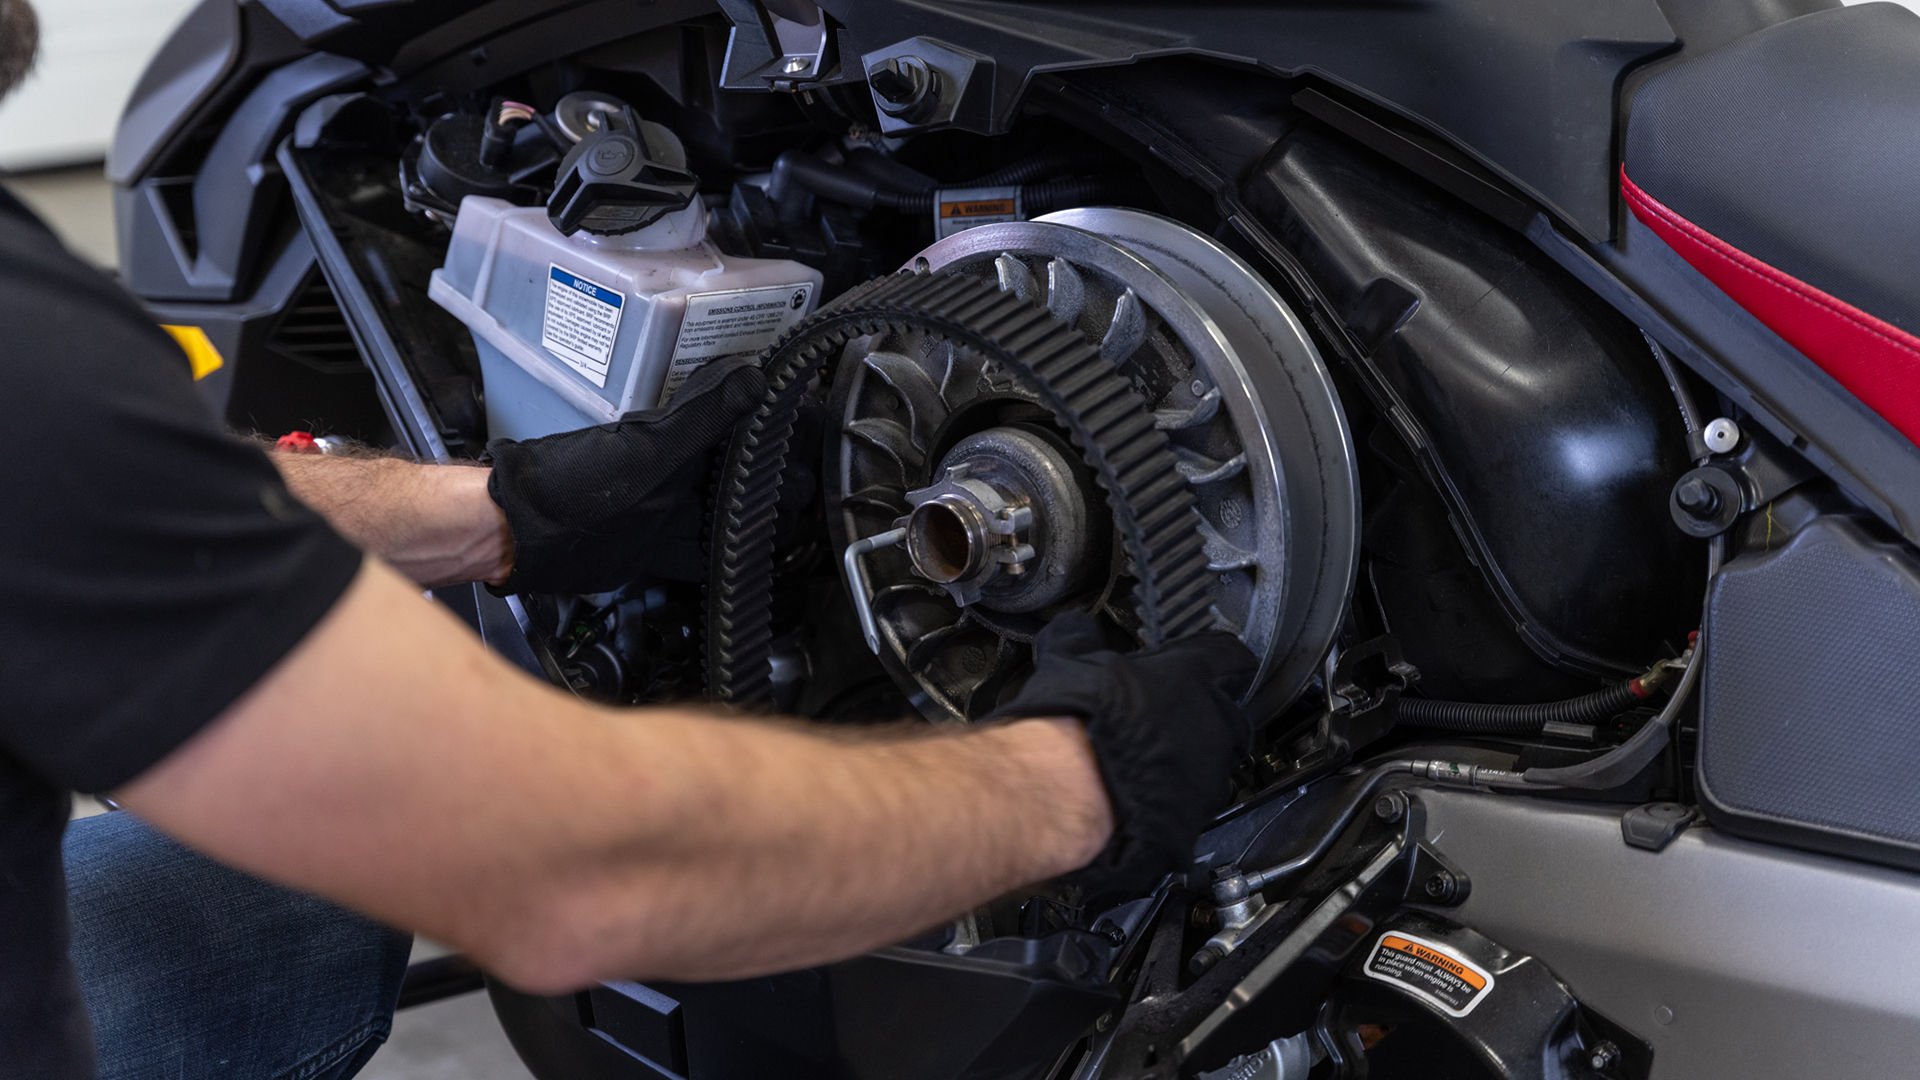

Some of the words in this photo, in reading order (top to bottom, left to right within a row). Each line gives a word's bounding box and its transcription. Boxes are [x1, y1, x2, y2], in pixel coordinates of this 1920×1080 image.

[964, 203, 1005, 214] WARNING
[573, 279, 597, 295] NOTICE
[558, 285, 568, 293] engine
[579, 294, 597, 306] snowmobile
[604, 305, 613, 313] been
[573, 299, 587, 310] validated
[707, 307, 734, 315] EMISSIONS
[733, 304, 756, 313] CONTROL
[756, 301, 786, 310] INFORMATION
[580, 331, 591, 340] engine
[601, 334, 611, 342] which
[1416, 947, 1464, 975] WARNING
[1375, 964, 1402, 977] running.
[1382, 948, 1394, 958] This
[1395, 953, 1416, 965] guard
[1415, 960, 1434, 972] must
[1434, 968, 1462, 989] ALWAYS
[1461, 983, 1472, 994] be
[1385, 958, 1404, 970] place
[1405, 965, 1423, 976] when
[1424, 973, 1448, 990] engine
[1447, 985, 1454, 993] is
